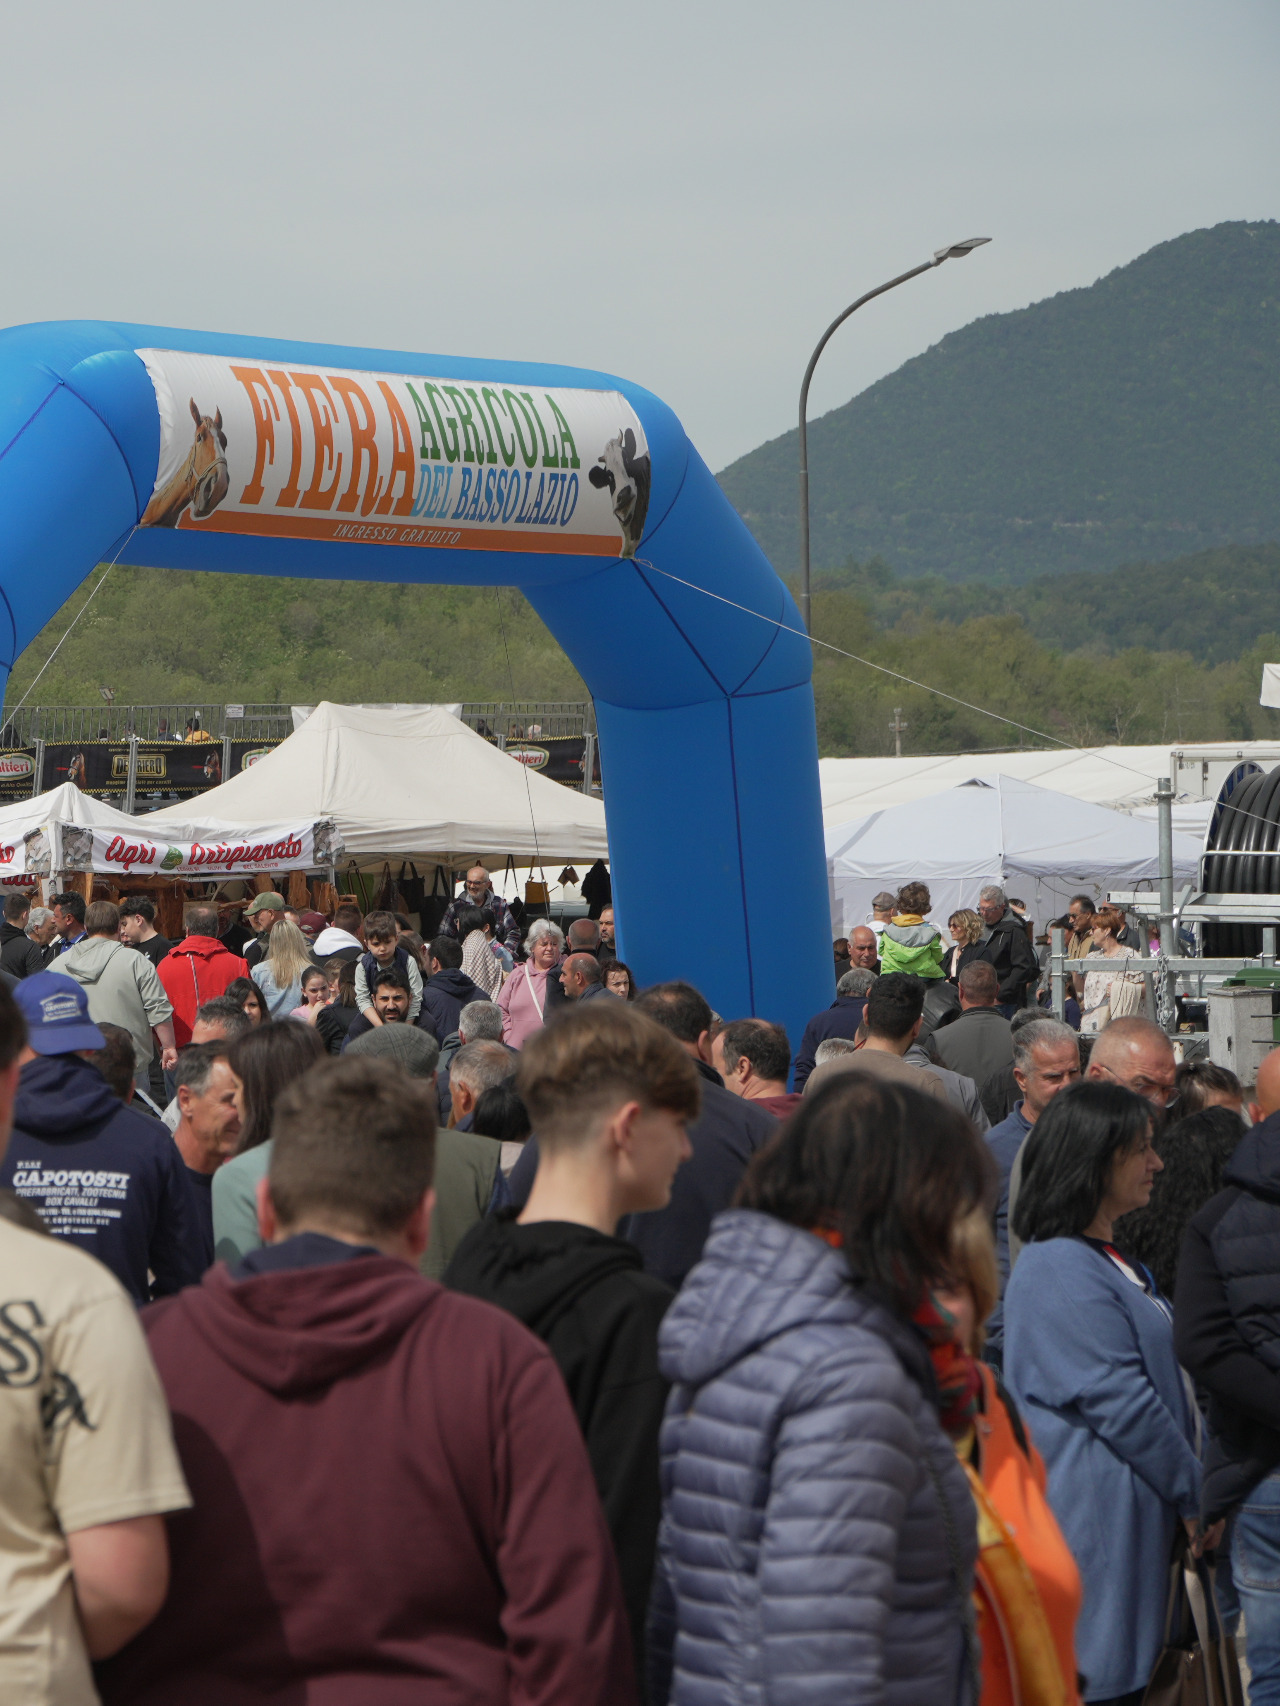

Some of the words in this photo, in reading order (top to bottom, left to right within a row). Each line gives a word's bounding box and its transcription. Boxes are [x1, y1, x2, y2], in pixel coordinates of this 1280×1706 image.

[229, 366, 419, 516] FIERA
[405, 382, 580, 468] AGRICOLA
[410, 463, 456, 519] DEL
[452, 466, 521, 523] BASSO
[514, 470, 580, 527] LAZIO
[332, 524, 397, 542] INGRESSO
[399, 528, 462, 545] GRATUITO
[116, 757, 162, 774] DERIERO
[507, 753, 543, 764] altieri
[187, 833, 303, 870] Artigianato
[12, 1170, 131, 1189] CAPOTOSTI
[45, 1197, 63, 1207] BOX
[64, 1197, 99, 1207] CAVALLI
[82, 1188, 127, 1199] ZOOTECNIA
